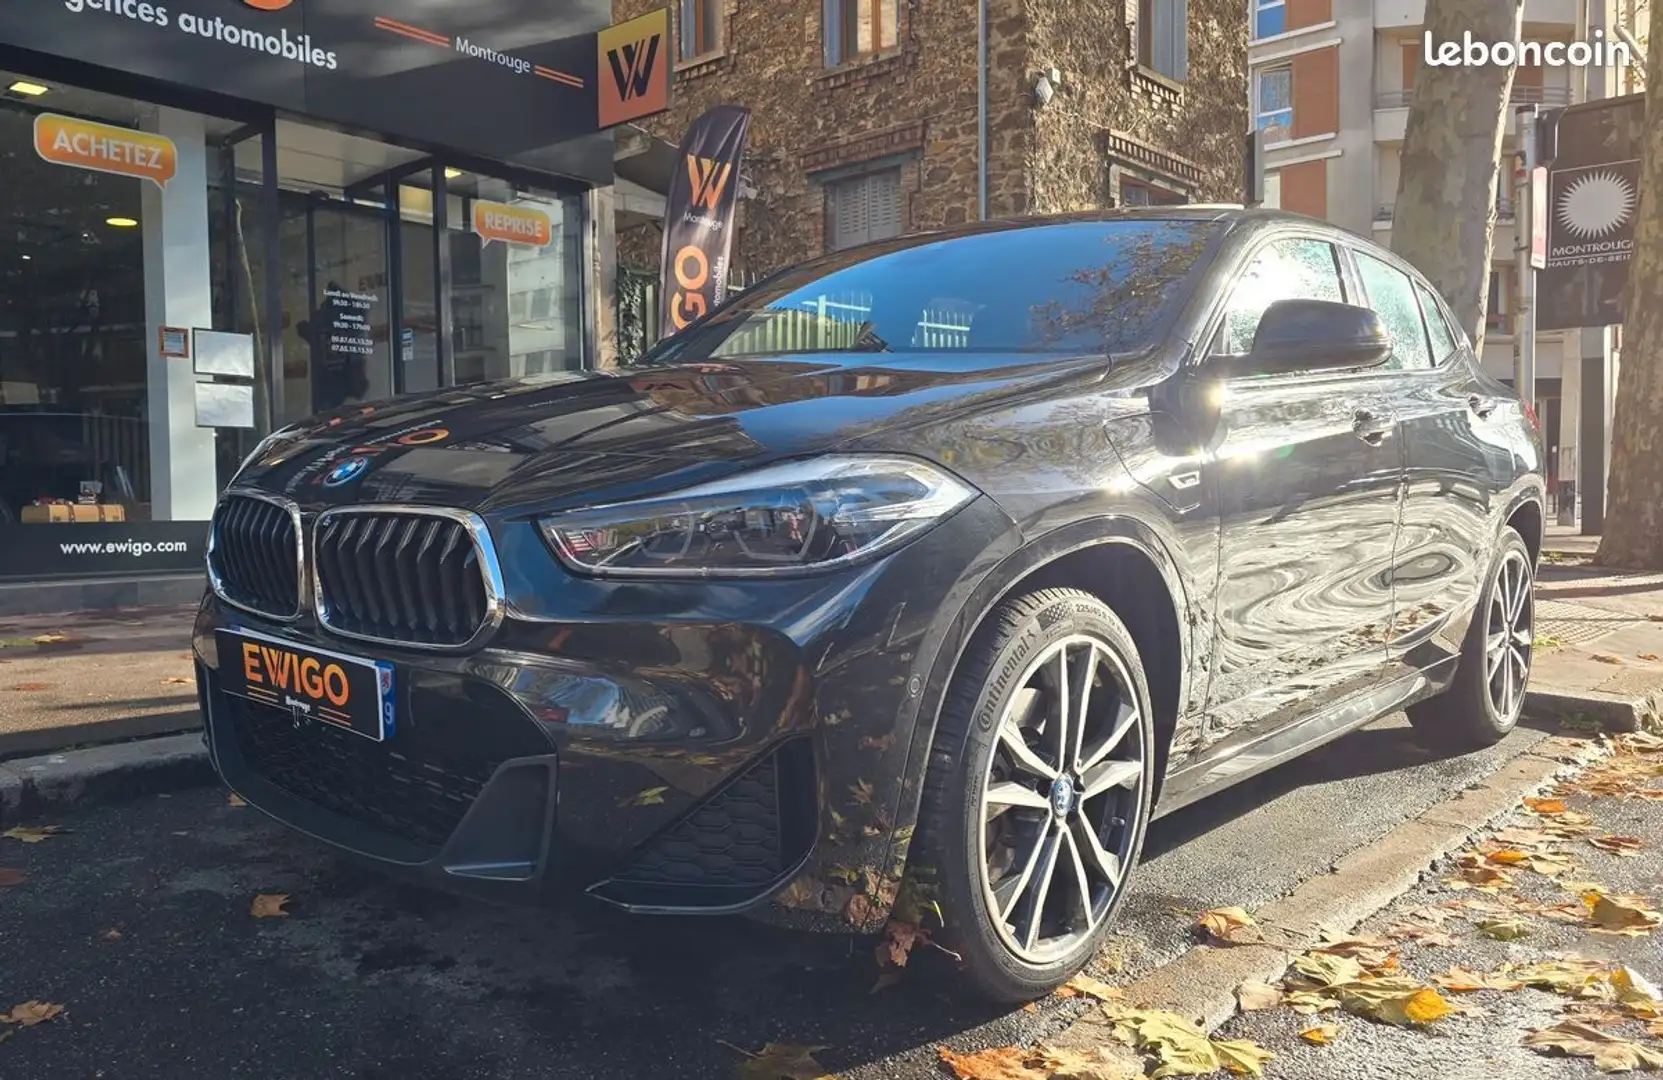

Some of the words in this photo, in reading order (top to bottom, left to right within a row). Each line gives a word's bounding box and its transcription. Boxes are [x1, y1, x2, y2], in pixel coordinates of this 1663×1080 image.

[178, 13, 337, 69] automobiles
[455, 36, 531, 74] Montrouge
[52, 128, 163, 169] ACHETEZ
[484, 211, 543, 237] REPRISE
[1552, 240, 1634, 256] MONTROUG
[60, 538, 187, 556] www.ewigo.com
[242, 642, 349, 706] EWIGO
[977, 636, 1030, 733] Continental
